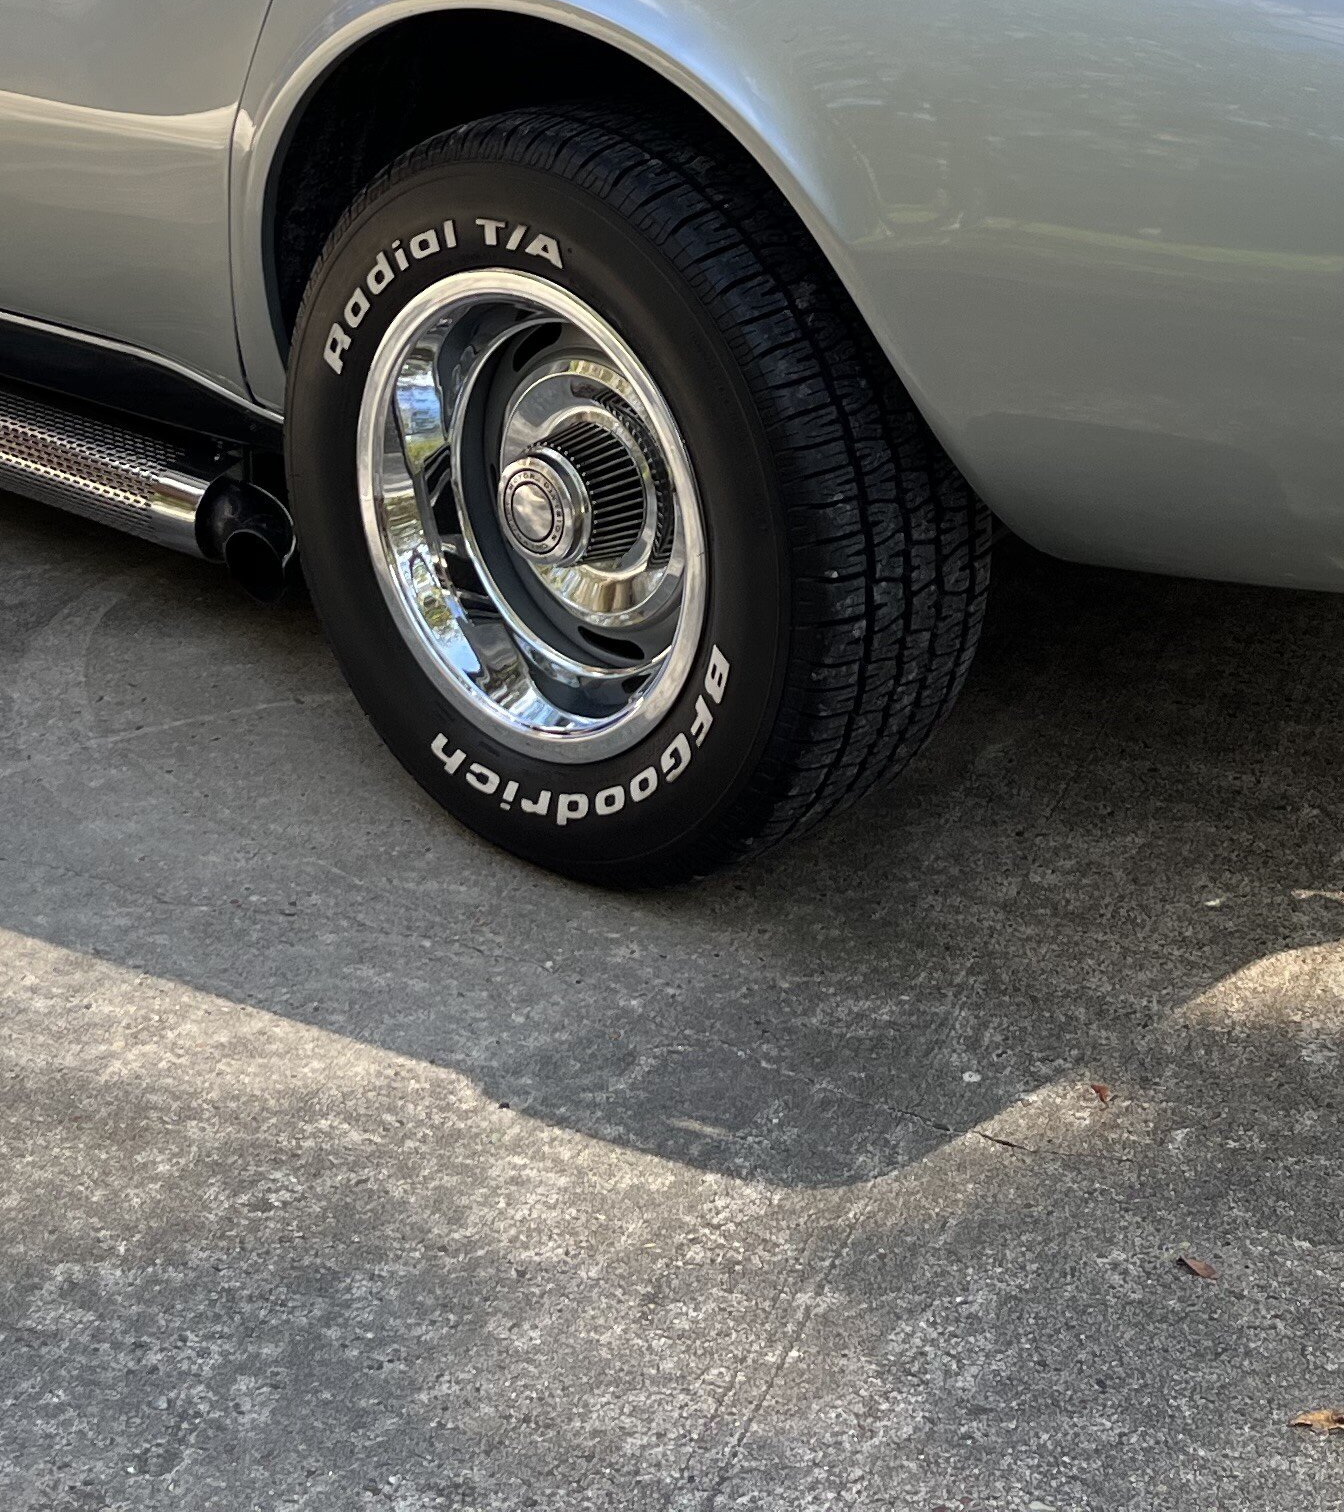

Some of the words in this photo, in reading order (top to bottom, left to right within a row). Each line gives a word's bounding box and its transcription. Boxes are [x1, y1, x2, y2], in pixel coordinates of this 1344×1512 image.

[323, 219, 457, 375] Radial
[475, 218, 563, 270] T/A
[430, 644, 731, 826] BFGoodrich
